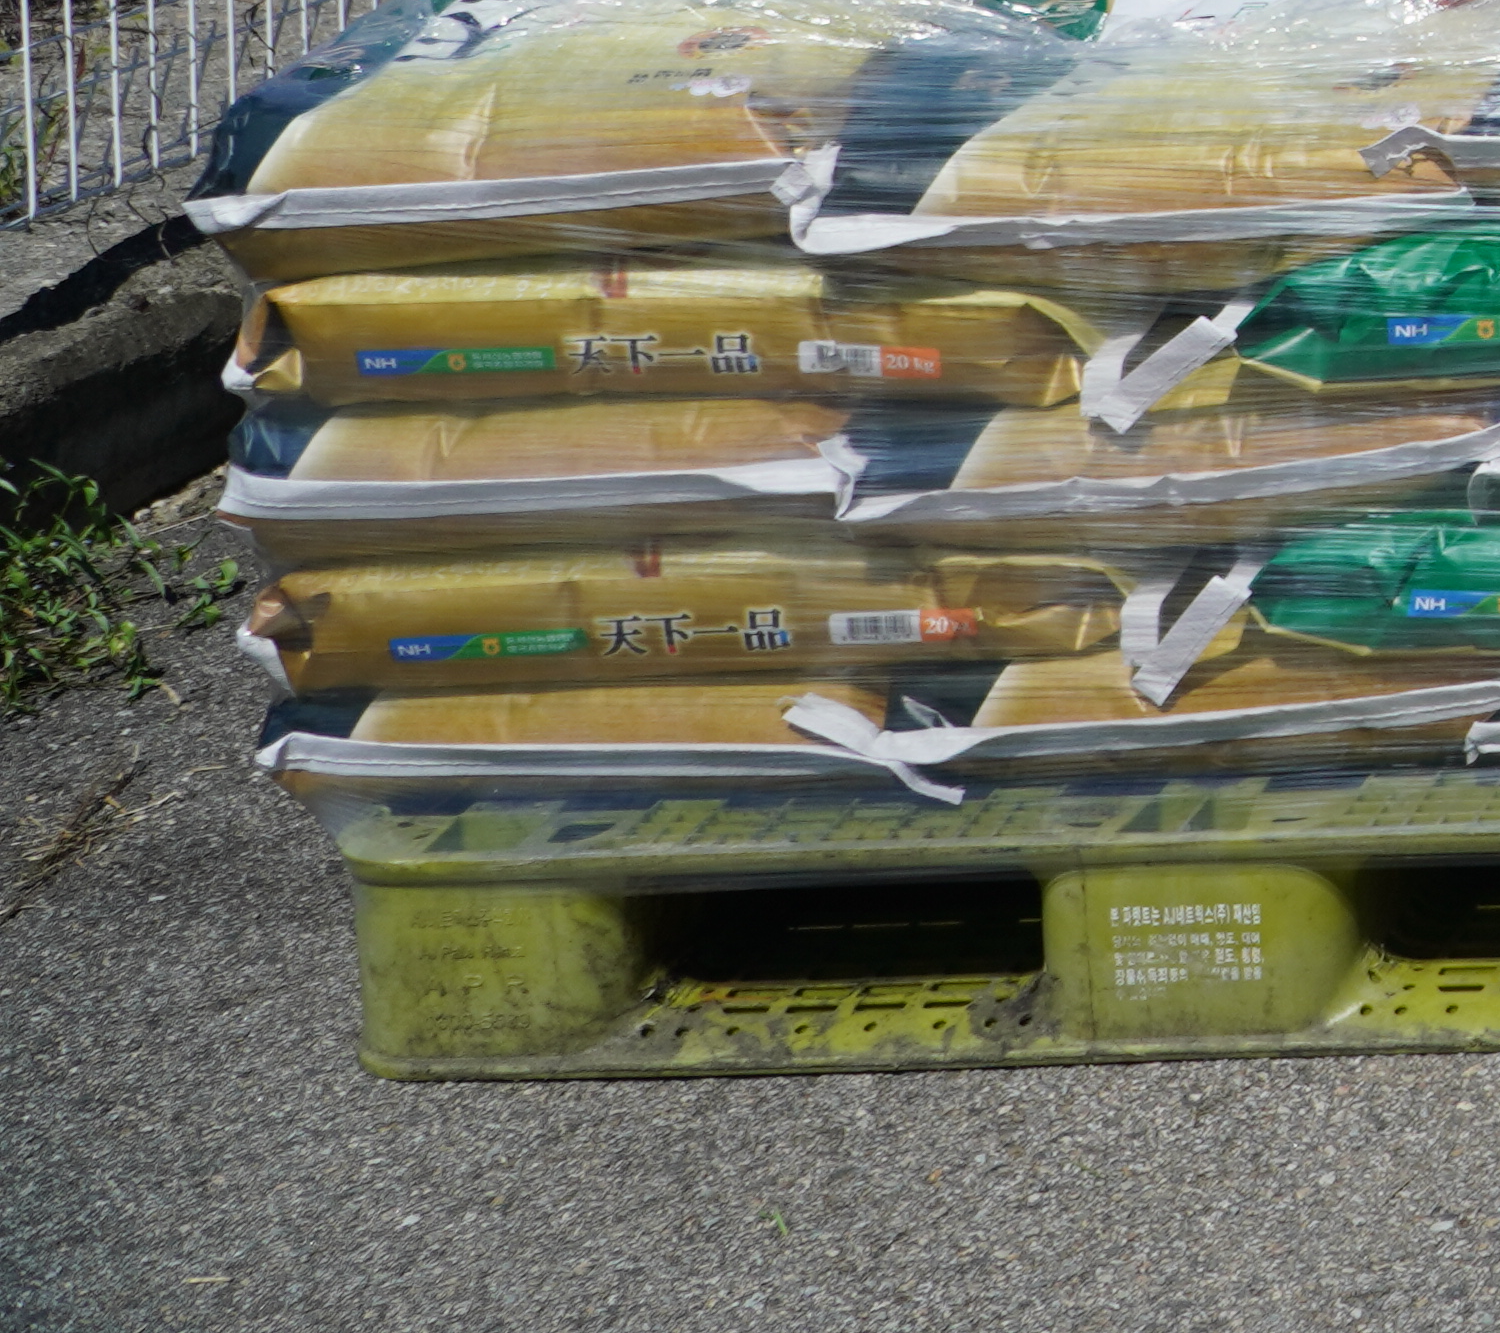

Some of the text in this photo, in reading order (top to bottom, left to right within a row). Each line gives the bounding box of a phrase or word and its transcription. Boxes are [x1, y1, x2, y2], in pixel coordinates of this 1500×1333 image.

[1395, 324, 1427, 337] NH
[564, 333, 759, 375] 天下一品
[886, 353, 911, 371] 20
[364, 358, 397, 370] NH
[1414, 597, 1447, 611] NH
[592, 608, 791, 656] 天下一品
[923, 616, 949, 634] 20
[397, 644, 432, 656] NH
